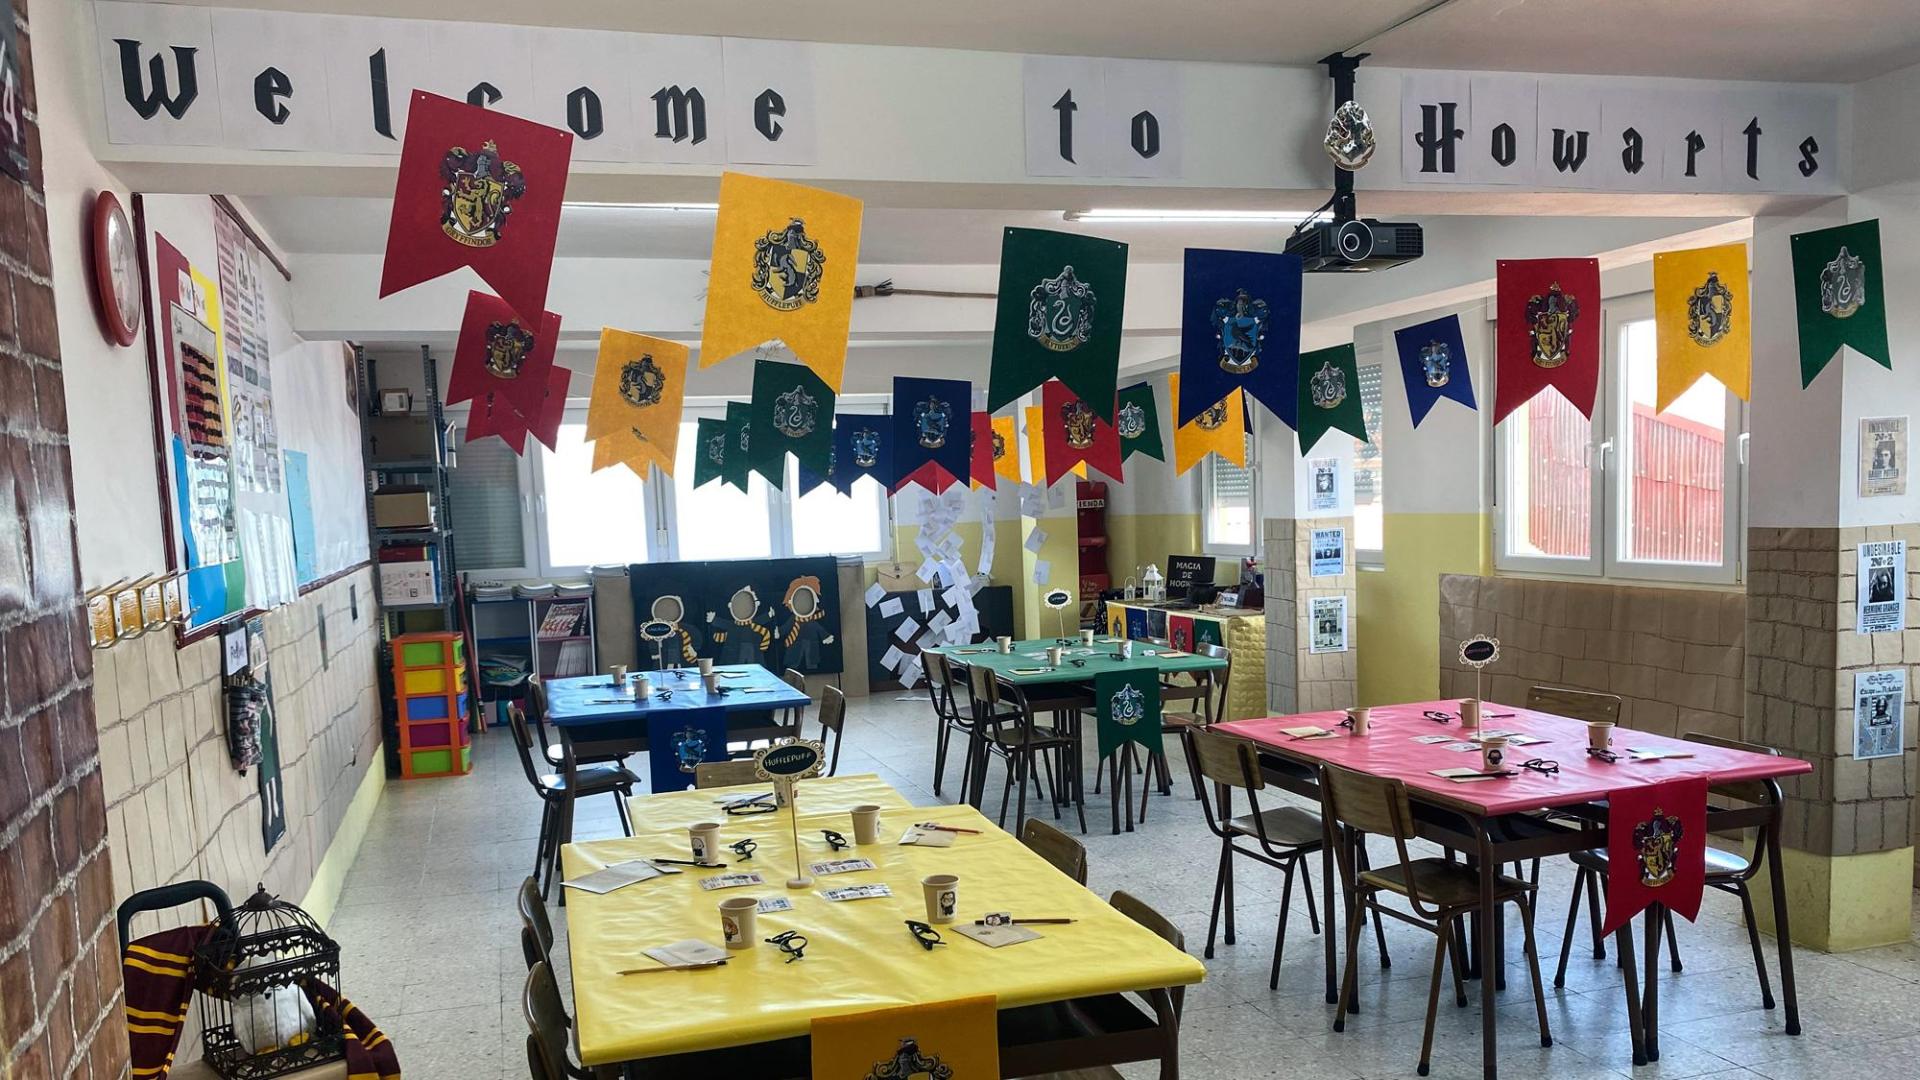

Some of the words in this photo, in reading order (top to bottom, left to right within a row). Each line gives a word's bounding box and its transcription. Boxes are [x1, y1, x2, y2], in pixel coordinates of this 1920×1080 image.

[1051, 88, 1161, 164] to
[1416, 102, 1819, 180] Howarts
[1078, 500, 1104, 508] IENDA
[1182, 571, 1193, 579] DE
[764, 752, 812, 767] HUFFLEPUFF
